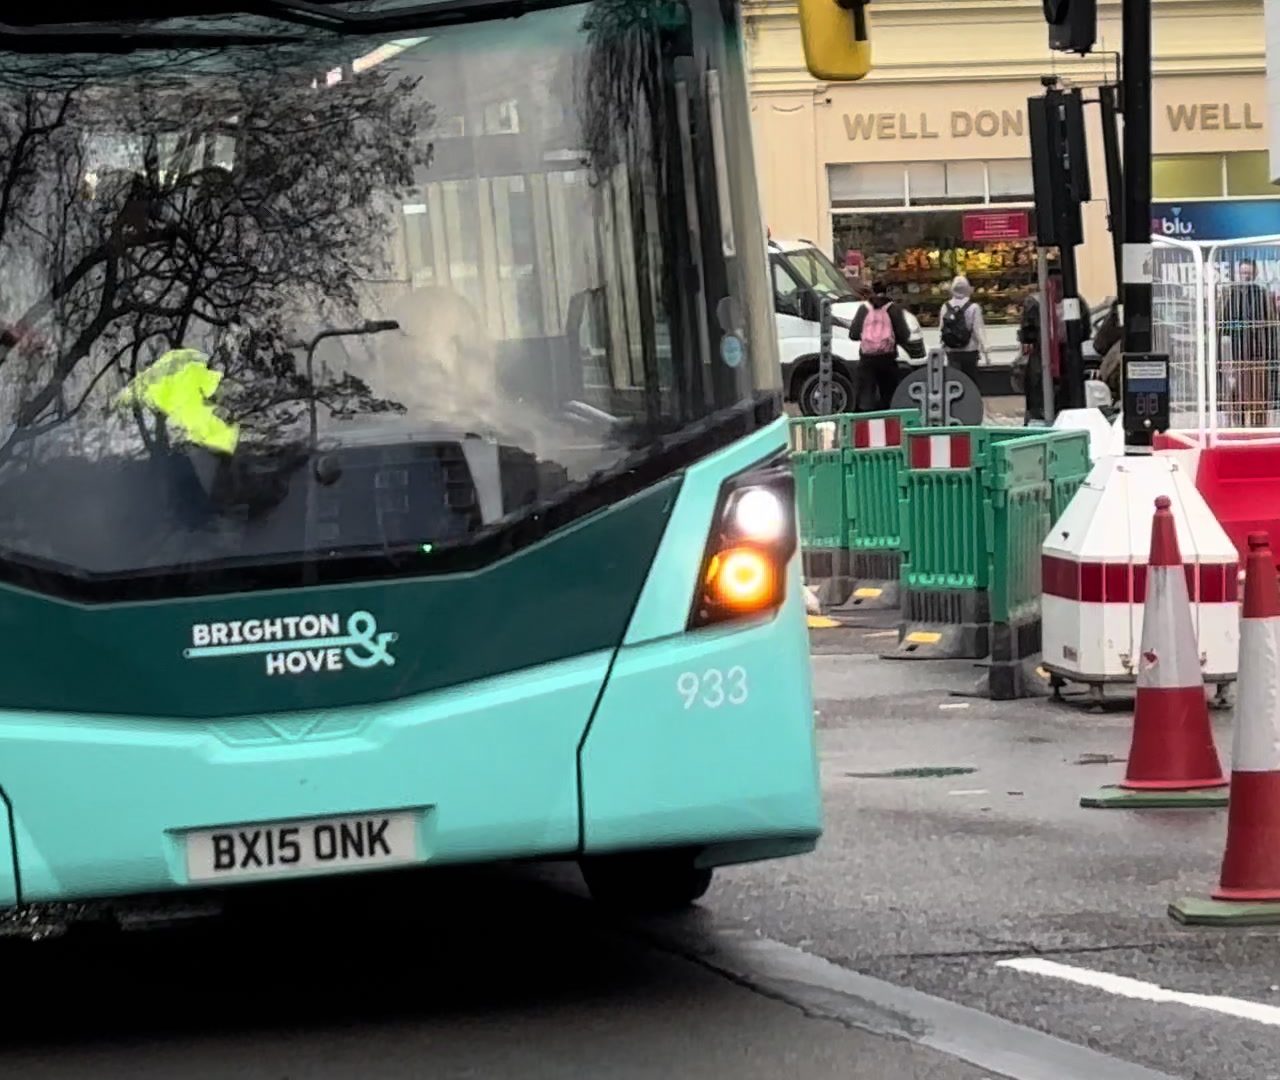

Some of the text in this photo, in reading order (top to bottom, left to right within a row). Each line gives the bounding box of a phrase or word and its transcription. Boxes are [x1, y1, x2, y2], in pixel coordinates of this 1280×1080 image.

[843, 109, 1024, 141] WELL DON
[1166, 103, 1264, 132] WELL
[1161, 217, 1193, 235] blu
[1161, 261, 1230, 283] INTESE
[192, 613, 340, 647] BRIGHTON
[266, 648, 343, 676] HOVE
[677, 665, 749, 710] 933
[212, 819, 392, 871] BX15 ONK
